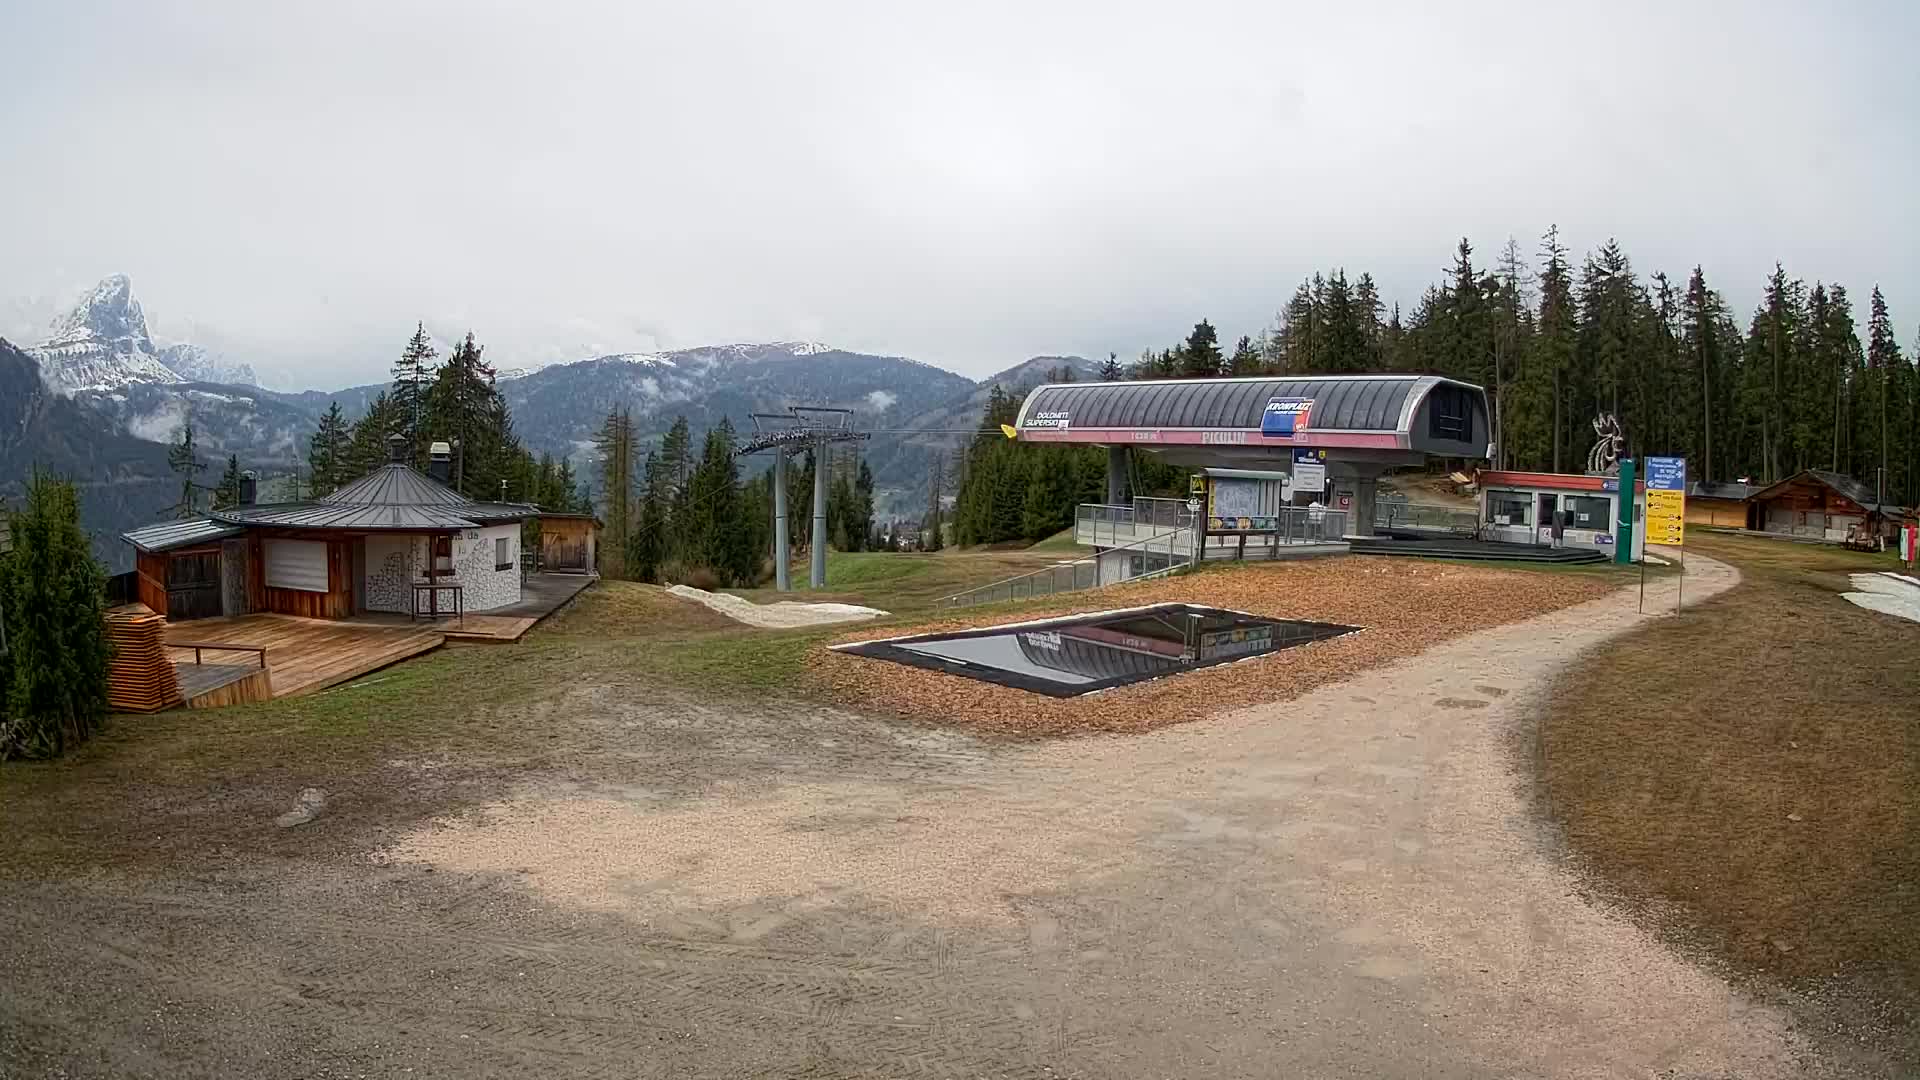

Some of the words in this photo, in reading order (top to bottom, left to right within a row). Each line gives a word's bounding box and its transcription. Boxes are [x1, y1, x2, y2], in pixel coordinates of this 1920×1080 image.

[1267, 402, 1312, 411] KRONPLATZ
[1036, 411, 1069, 419] DOLOMITI
[1025, 419, 1058, 427] SUPERSKI
[1201, 431, 1246, 445] PICULIN
